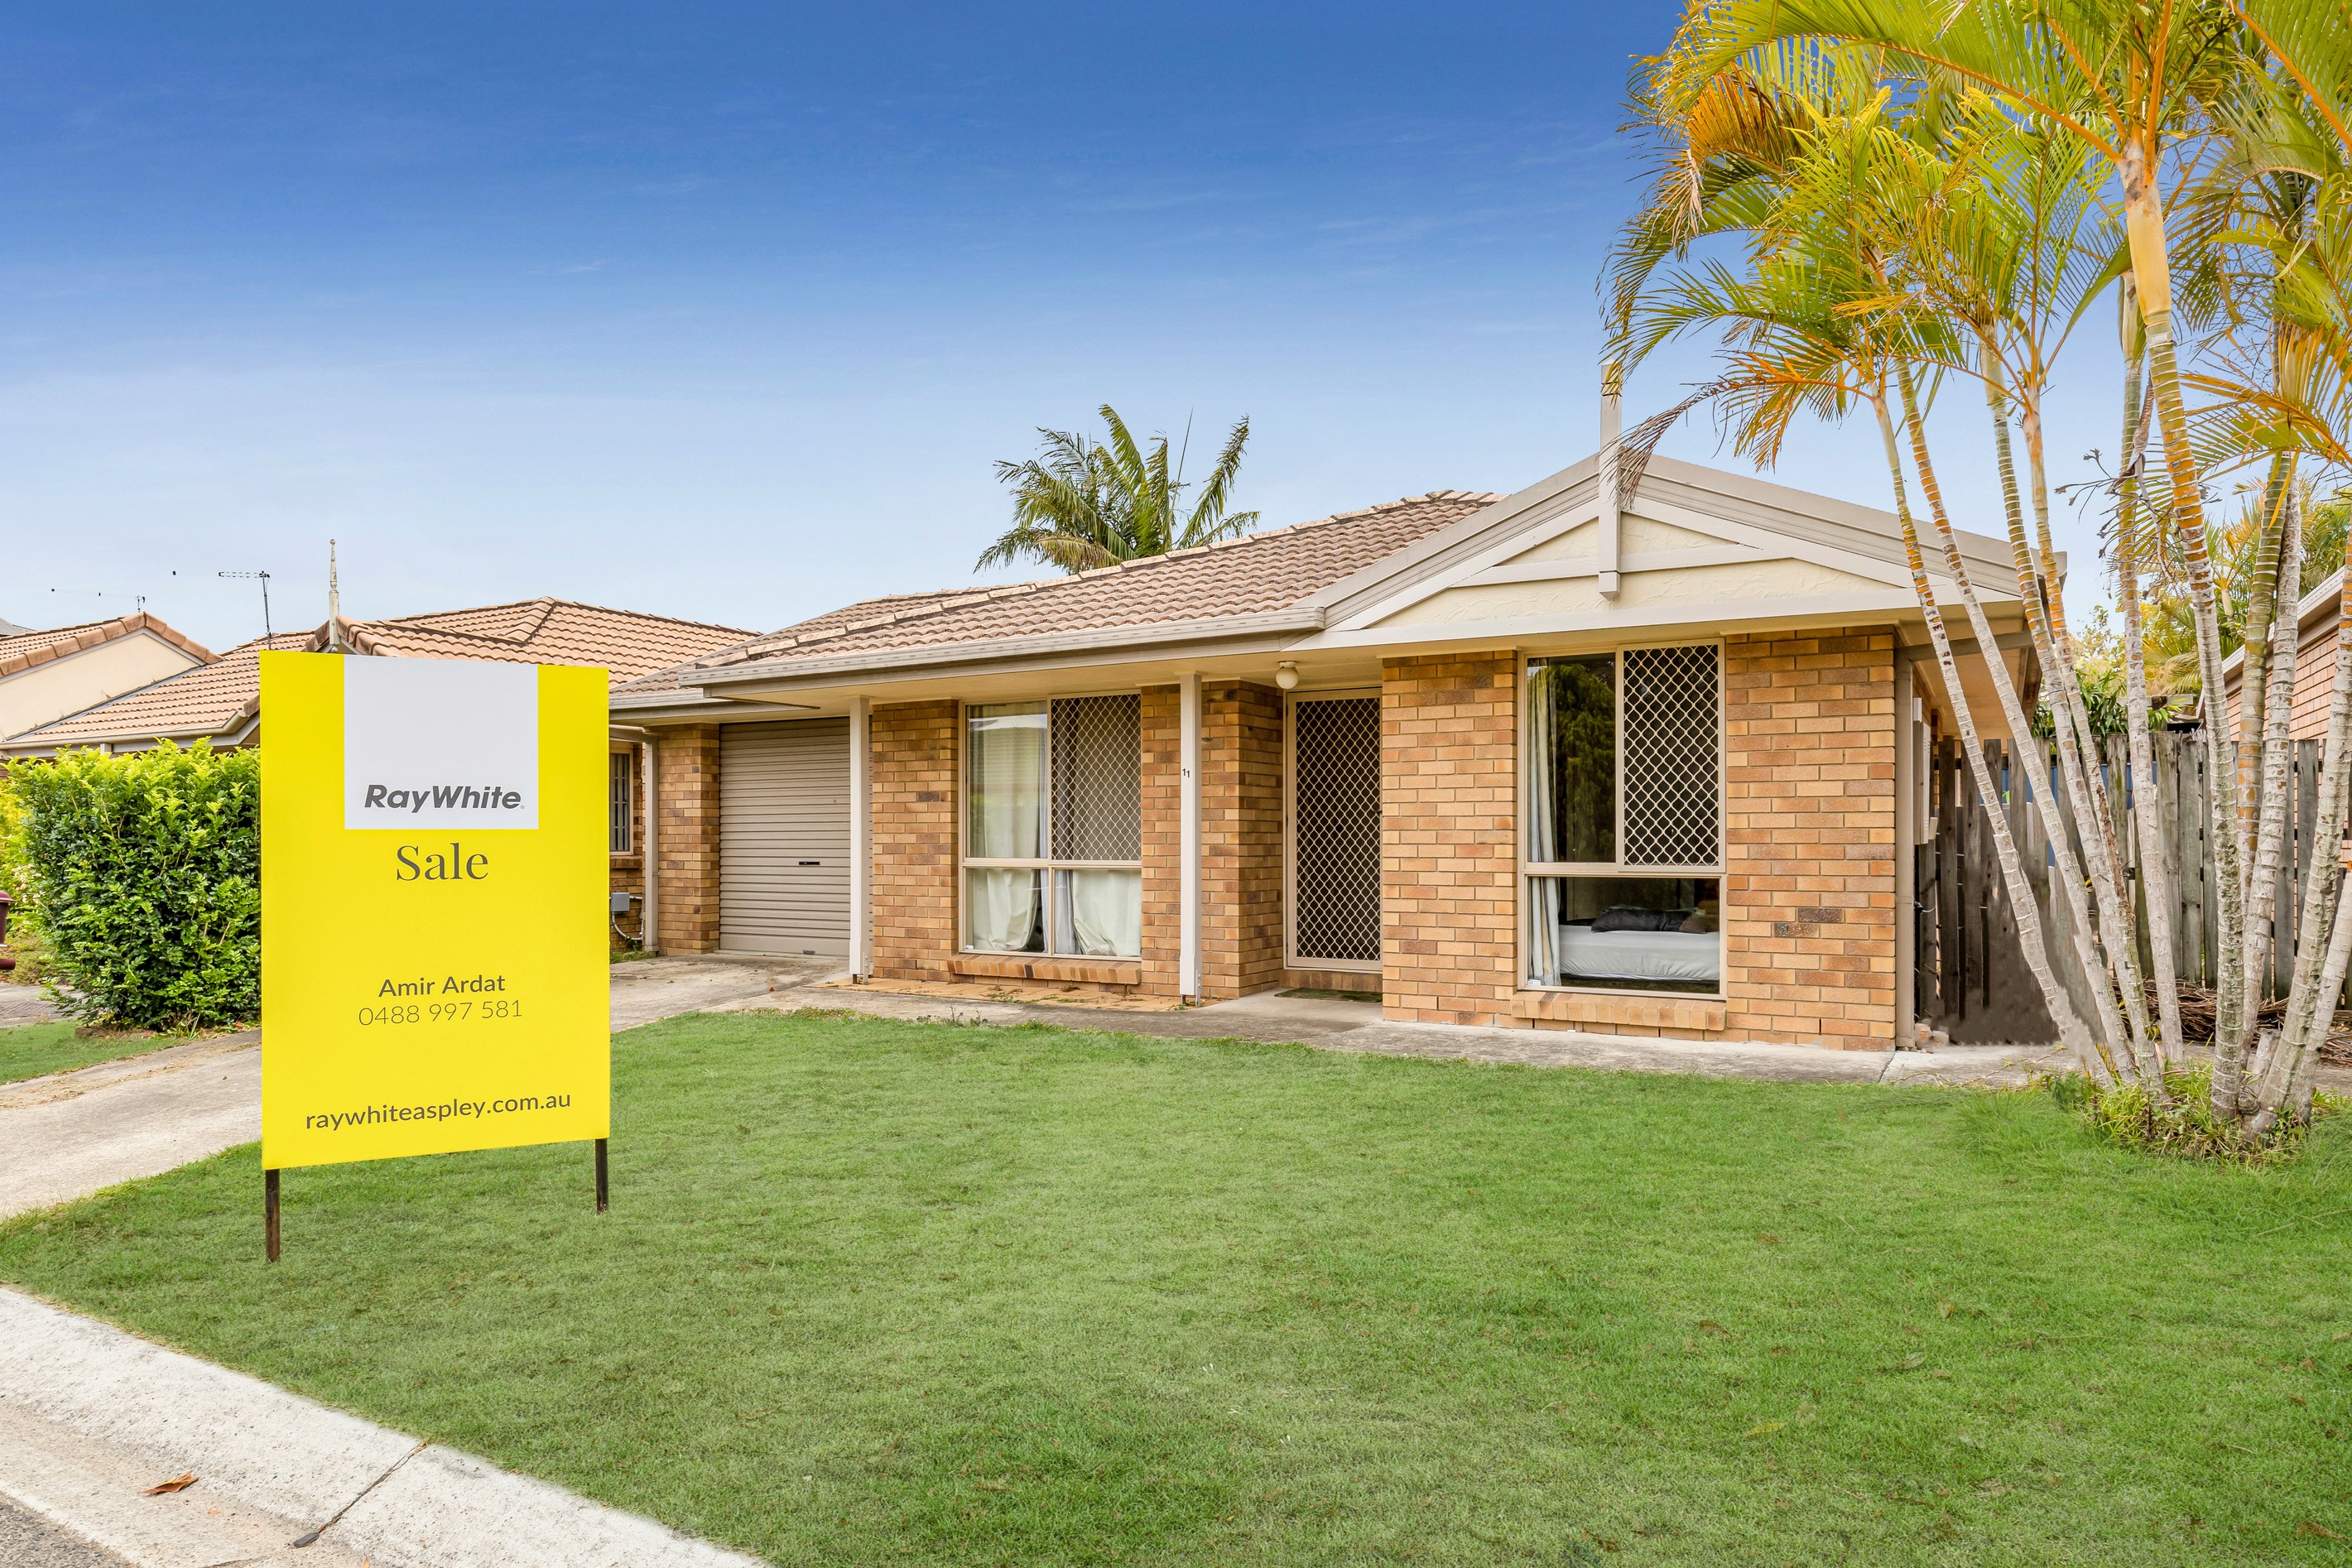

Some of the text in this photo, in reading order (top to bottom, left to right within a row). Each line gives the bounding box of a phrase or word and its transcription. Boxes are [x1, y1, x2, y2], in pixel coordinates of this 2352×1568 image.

[1182, 768, 1190, 778] 11
[396, 842, 489, 882] Sale
[378, 974, 506, 998] Amir Ardat
[358, 999, 522, 1027] 0488 997 581
[305, 1094, 571, 1132] raywhiteaspley.com.au
